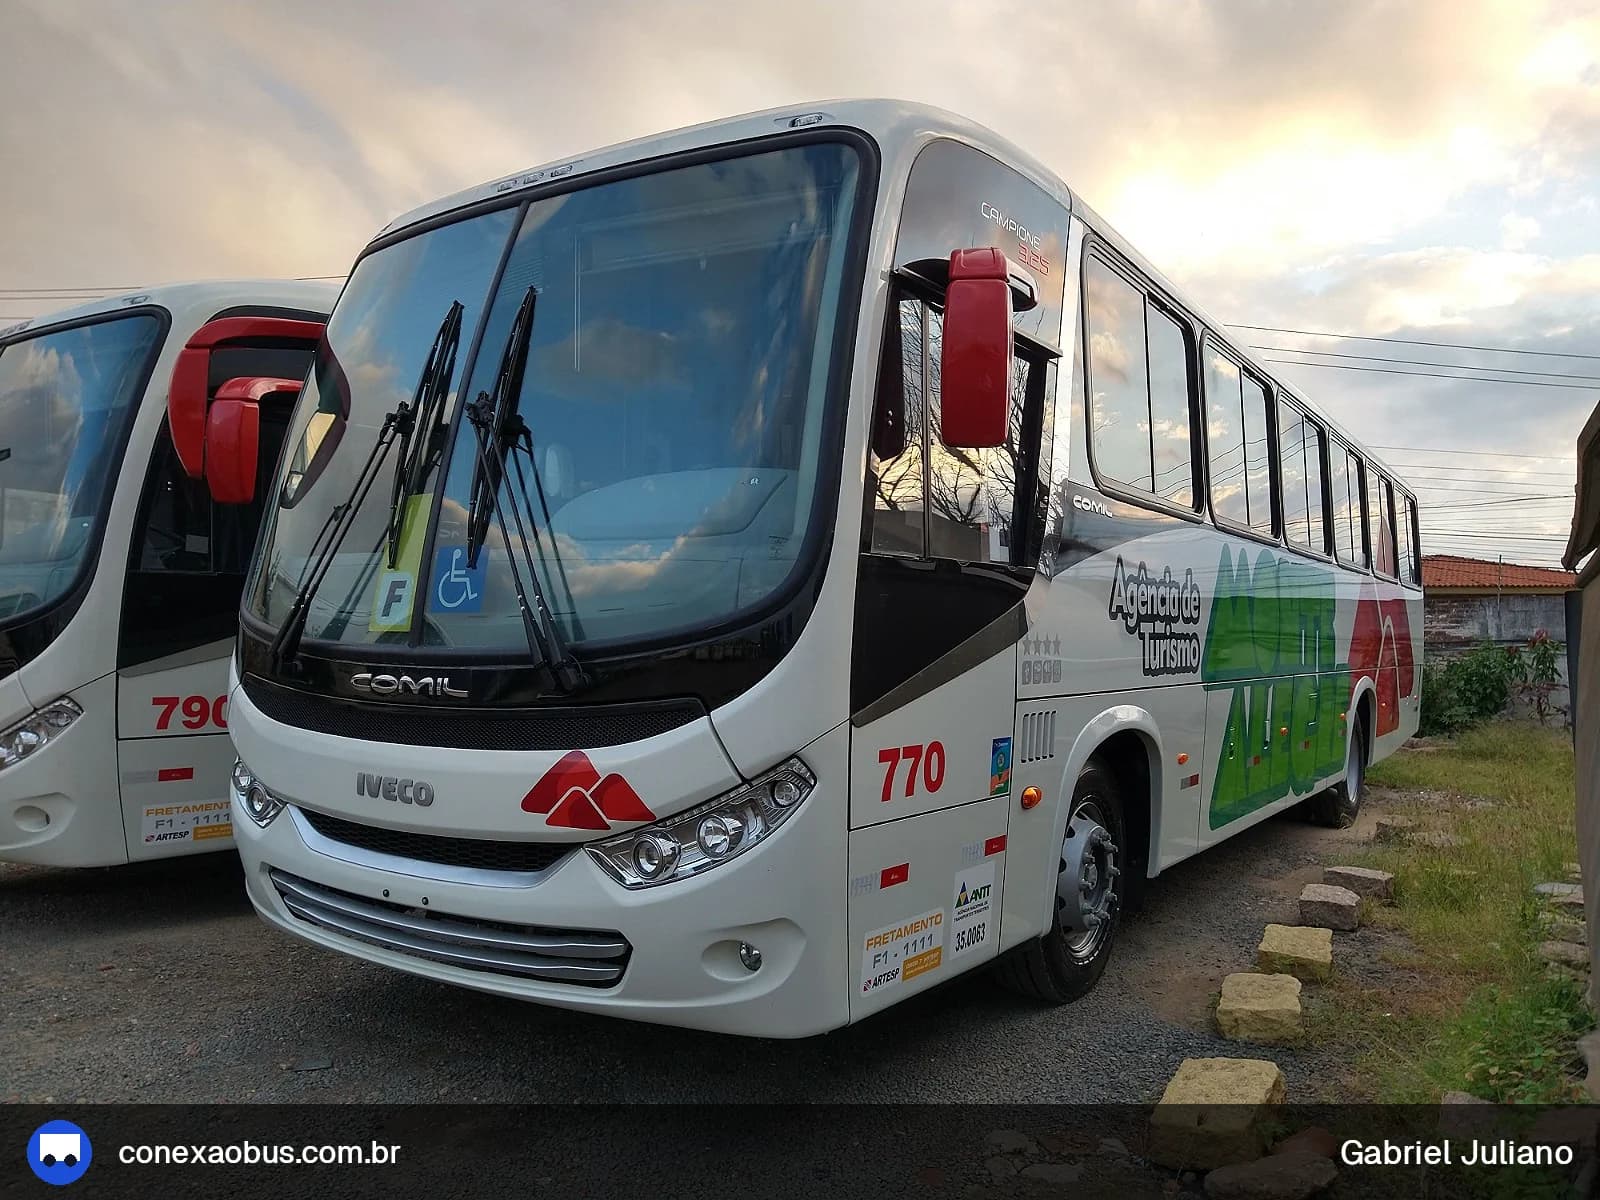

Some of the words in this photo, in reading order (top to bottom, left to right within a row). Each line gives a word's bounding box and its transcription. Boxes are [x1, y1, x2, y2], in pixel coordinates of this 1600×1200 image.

[981, 202, 1041, 250] CAMPIONE
[1018, 242, 1049, 276] 3.25
[1073, 495, 1113, 518] COMIL
[381, 580, 407, 617] F
[1109, 554, 1181, 633] Agência
[1181, 568, 1200, 624] de
[1138, 622, 1200, 676] Turismo
[350, 673, 469, 698] COMIL
[878, 740, 946, 802] 770
[356, 772, 434, 807] IVECO
[146, 801, 232, 816] FRETAMENT
[155, 818, 173, 829] F1
[193, 812, 231, 825] 1111
[156, 830, 190, 842] ARTESP
[970, 884, 992, 902] ANTT
[866, 912, 943, 951] FRETAMENTO
[872, 950, 888, 969] F1
[903, 933, 934, 955] 1111
[872, 967, 900, 988] ARTESP
